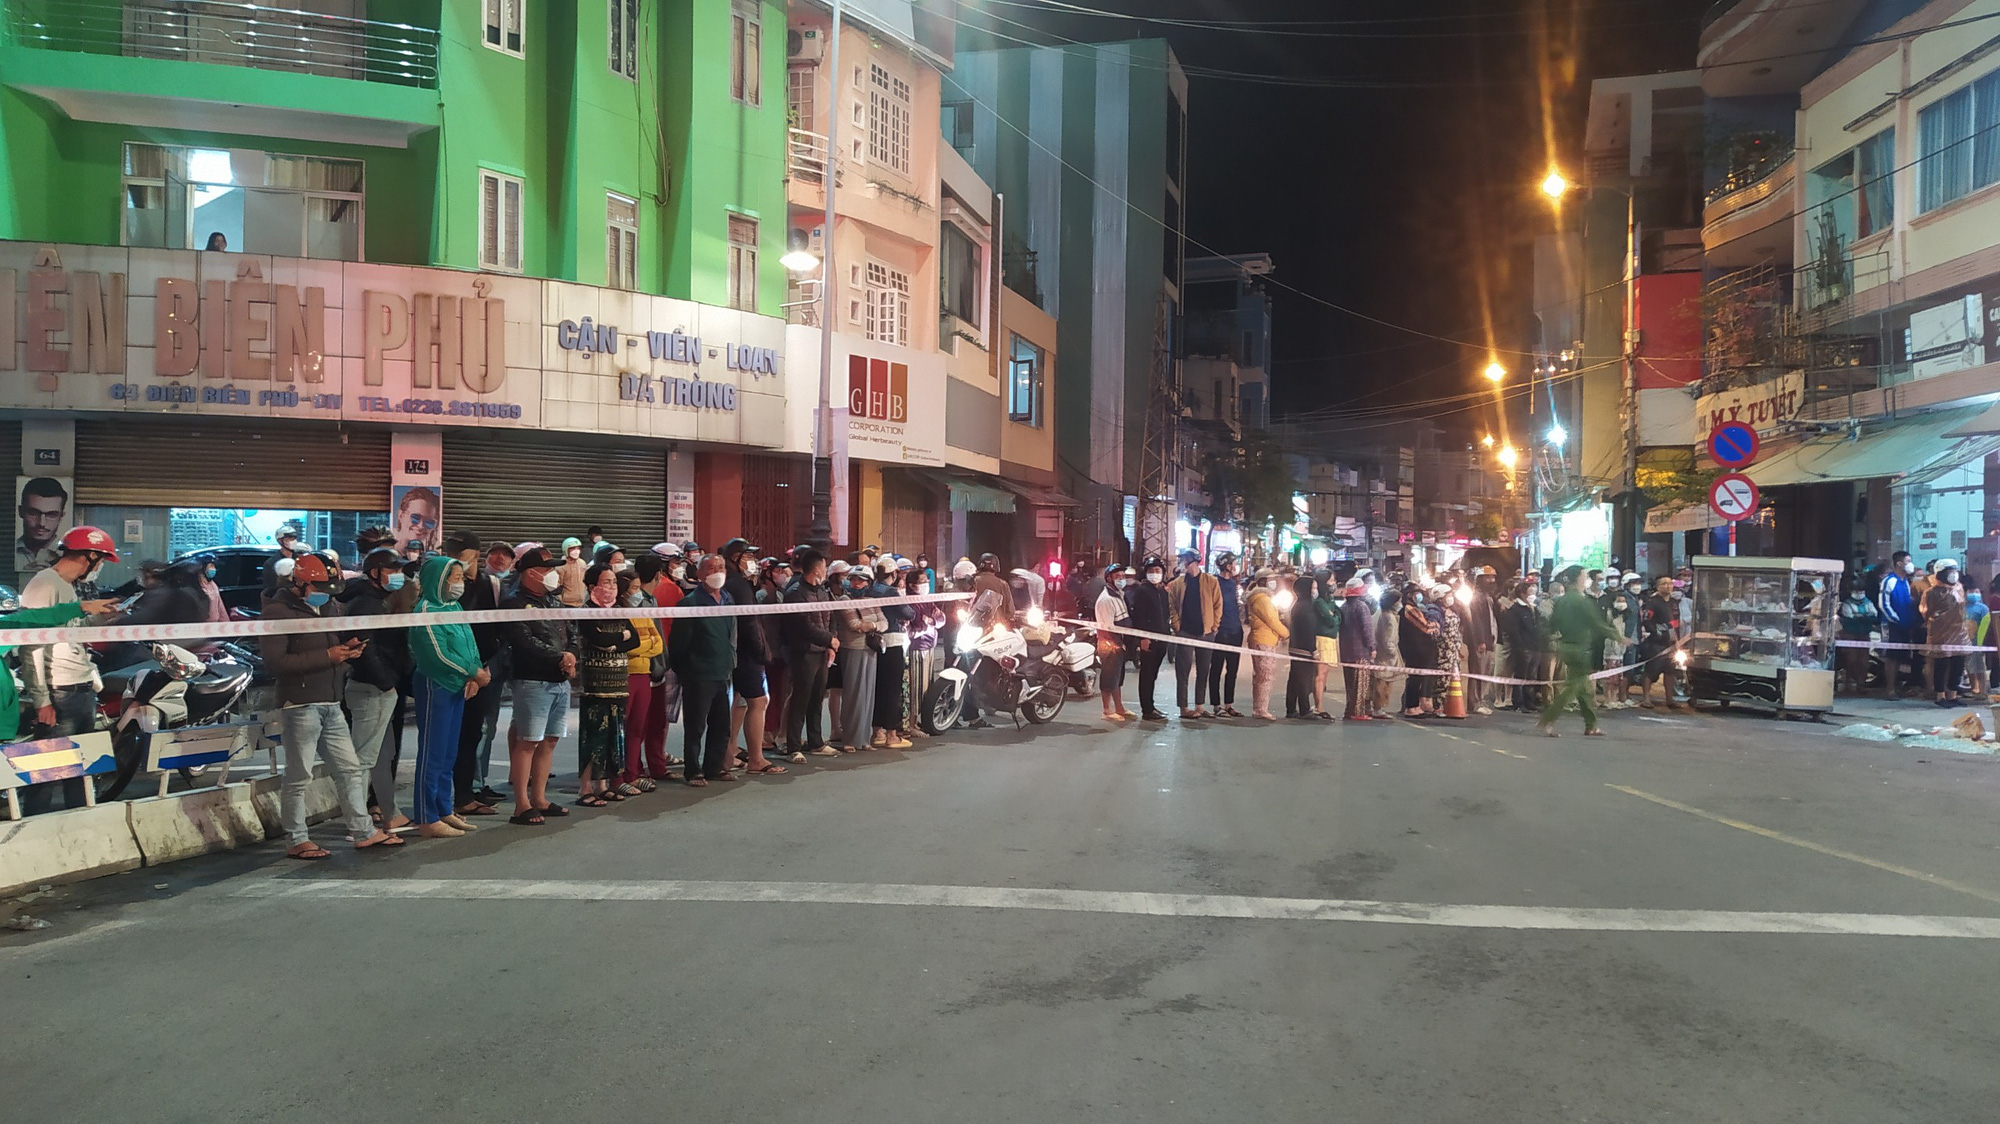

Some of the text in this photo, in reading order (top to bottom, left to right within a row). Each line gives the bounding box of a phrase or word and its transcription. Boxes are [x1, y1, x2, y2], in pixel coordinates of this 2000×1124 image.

[156, 260, 325, 383] BIÊN
[362, 278, 506, 394] PHỦ
[558, 316, 618, 359] CẬN
[726, 342, 778, 381] LOẠN
[619, 372, 737, 412] ĐA TRÒNG
[848, 421, 904, 436] CORPORATION
[848, 433, 868, 442] Global
[408, 460, 427, 470] 174
[993, 644, 1012, 654] POLICE
